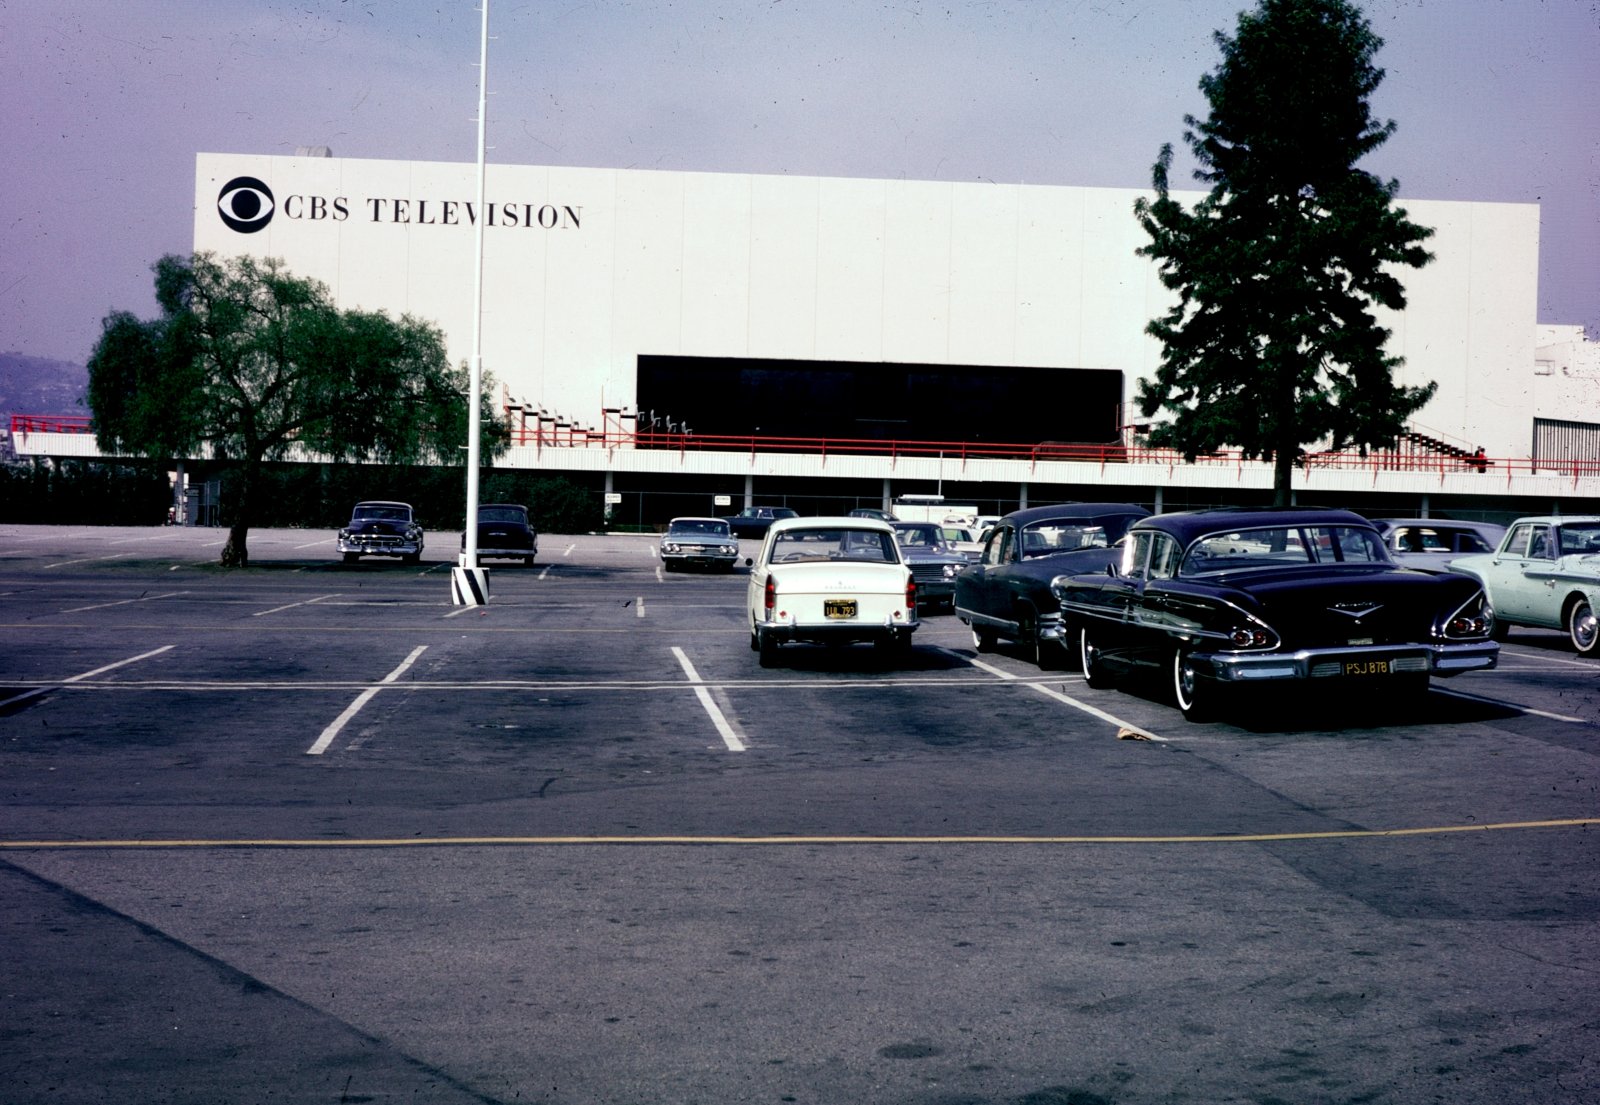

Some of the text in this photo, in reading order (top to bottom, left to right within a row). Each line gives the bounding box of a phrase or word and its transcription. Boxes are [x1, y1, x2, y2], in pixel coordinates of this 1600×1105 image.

[284, 194, 583, 229] CBS TELEVISION
[841, 606, 855, 616] 793
[1346, 661, 1387, 674] PSJ 878
